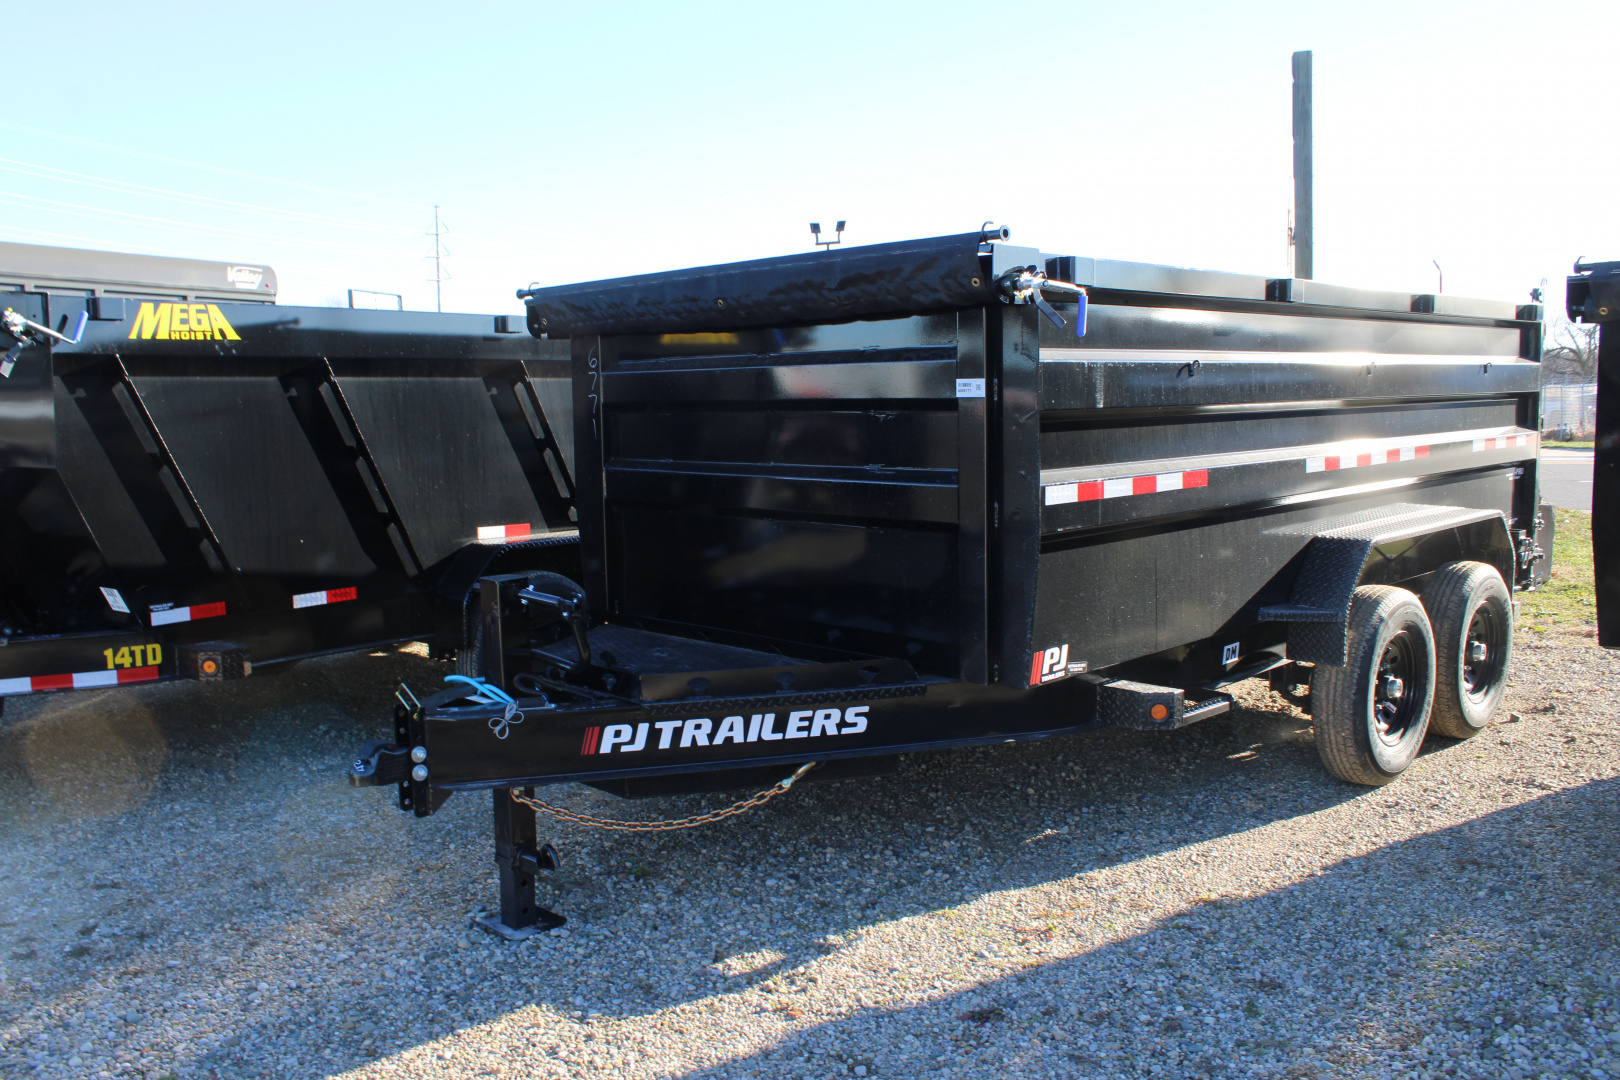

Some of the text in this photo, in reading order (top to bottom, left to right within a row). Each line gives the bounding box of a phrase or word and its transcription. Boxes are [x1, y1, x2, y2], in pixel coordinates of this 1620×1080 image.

[128, 302, 242, 340] MEGA
[170, 331, 212, 340] HOIST
[587, 344, 598, 440] 6771
[103, 643, 162, 670] 14TD
[1041, 643, 1069, 675] PJ
[599, 705, 870, 754] PJ TRAILERS
